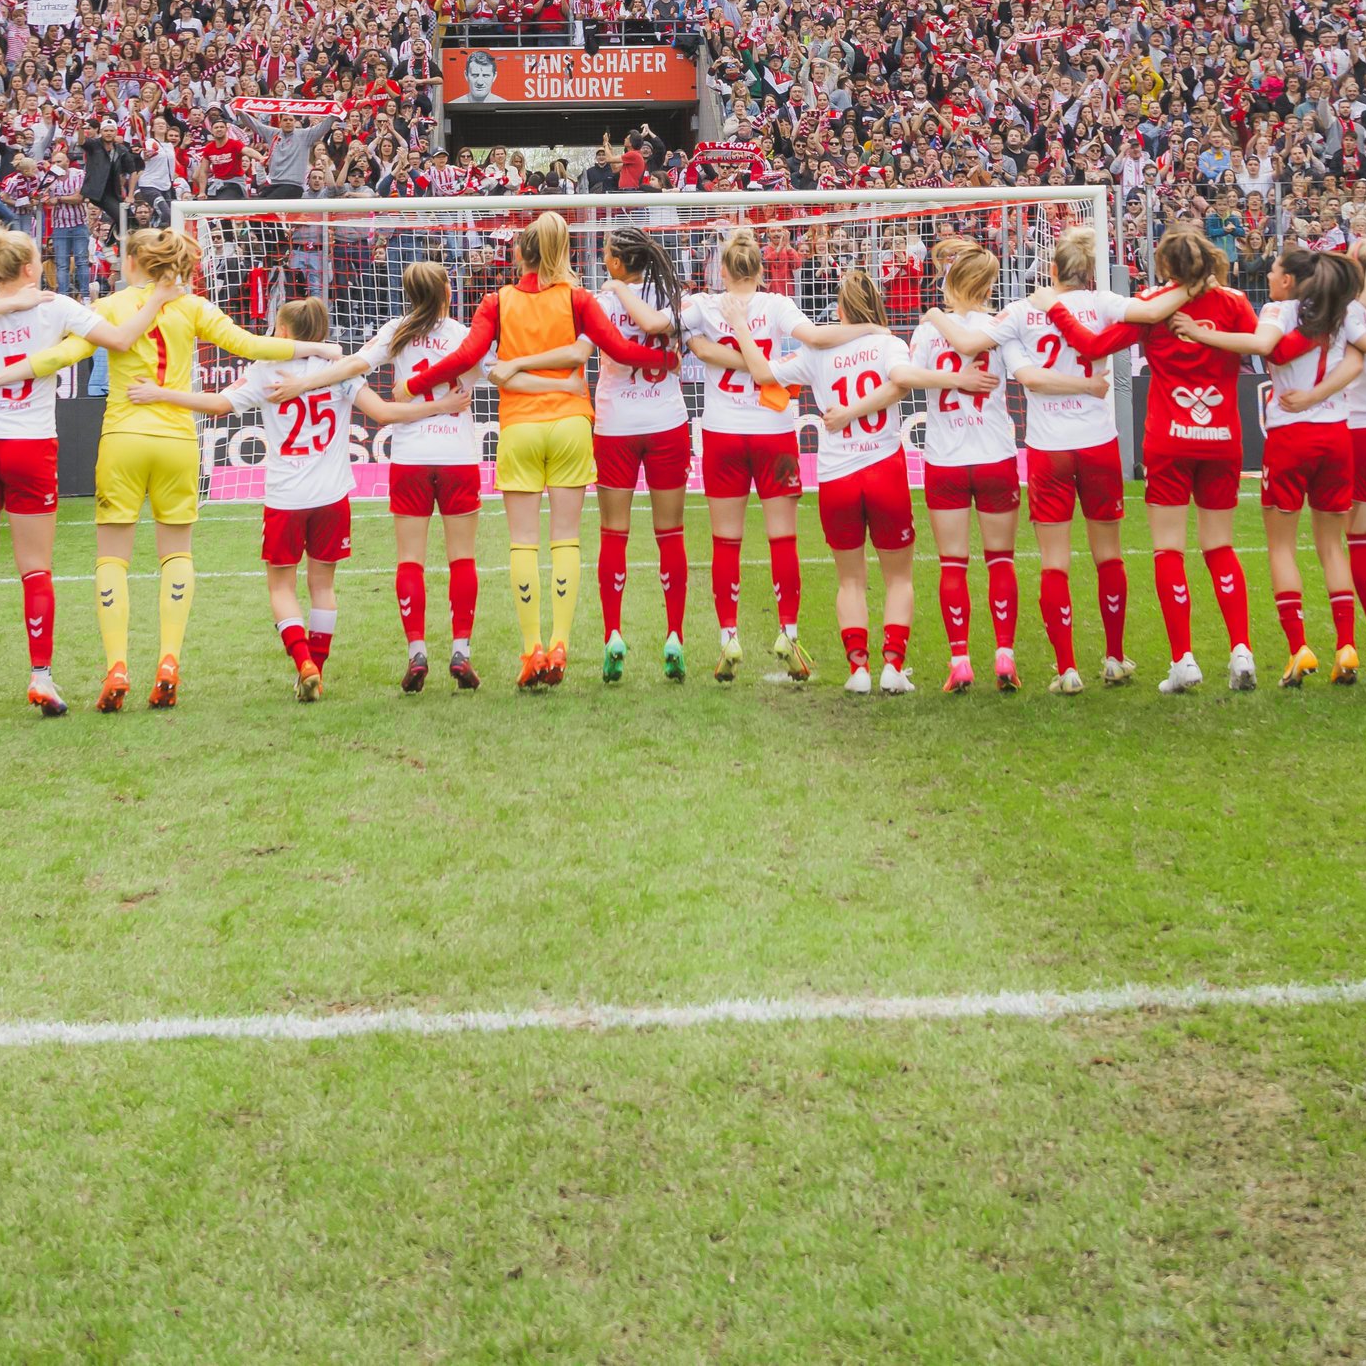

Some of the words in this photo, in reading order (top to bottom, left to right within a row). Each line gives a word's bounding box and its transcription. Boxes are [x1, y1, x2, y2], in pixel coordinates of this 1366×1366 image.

[524, 53, 575, 74] HANS
[580, 49, 667, 74] SCHÄFER
[524, 74, 625, 99] SÜDKURVE
[147, 325, 167, 387] 1
[412, 336, 449, 351] BIENZ
[1061, 398, 1083, 410] KÖLN
[278, 391, 336, 457] 25
[1169, 419, 1233, 441] hummel
